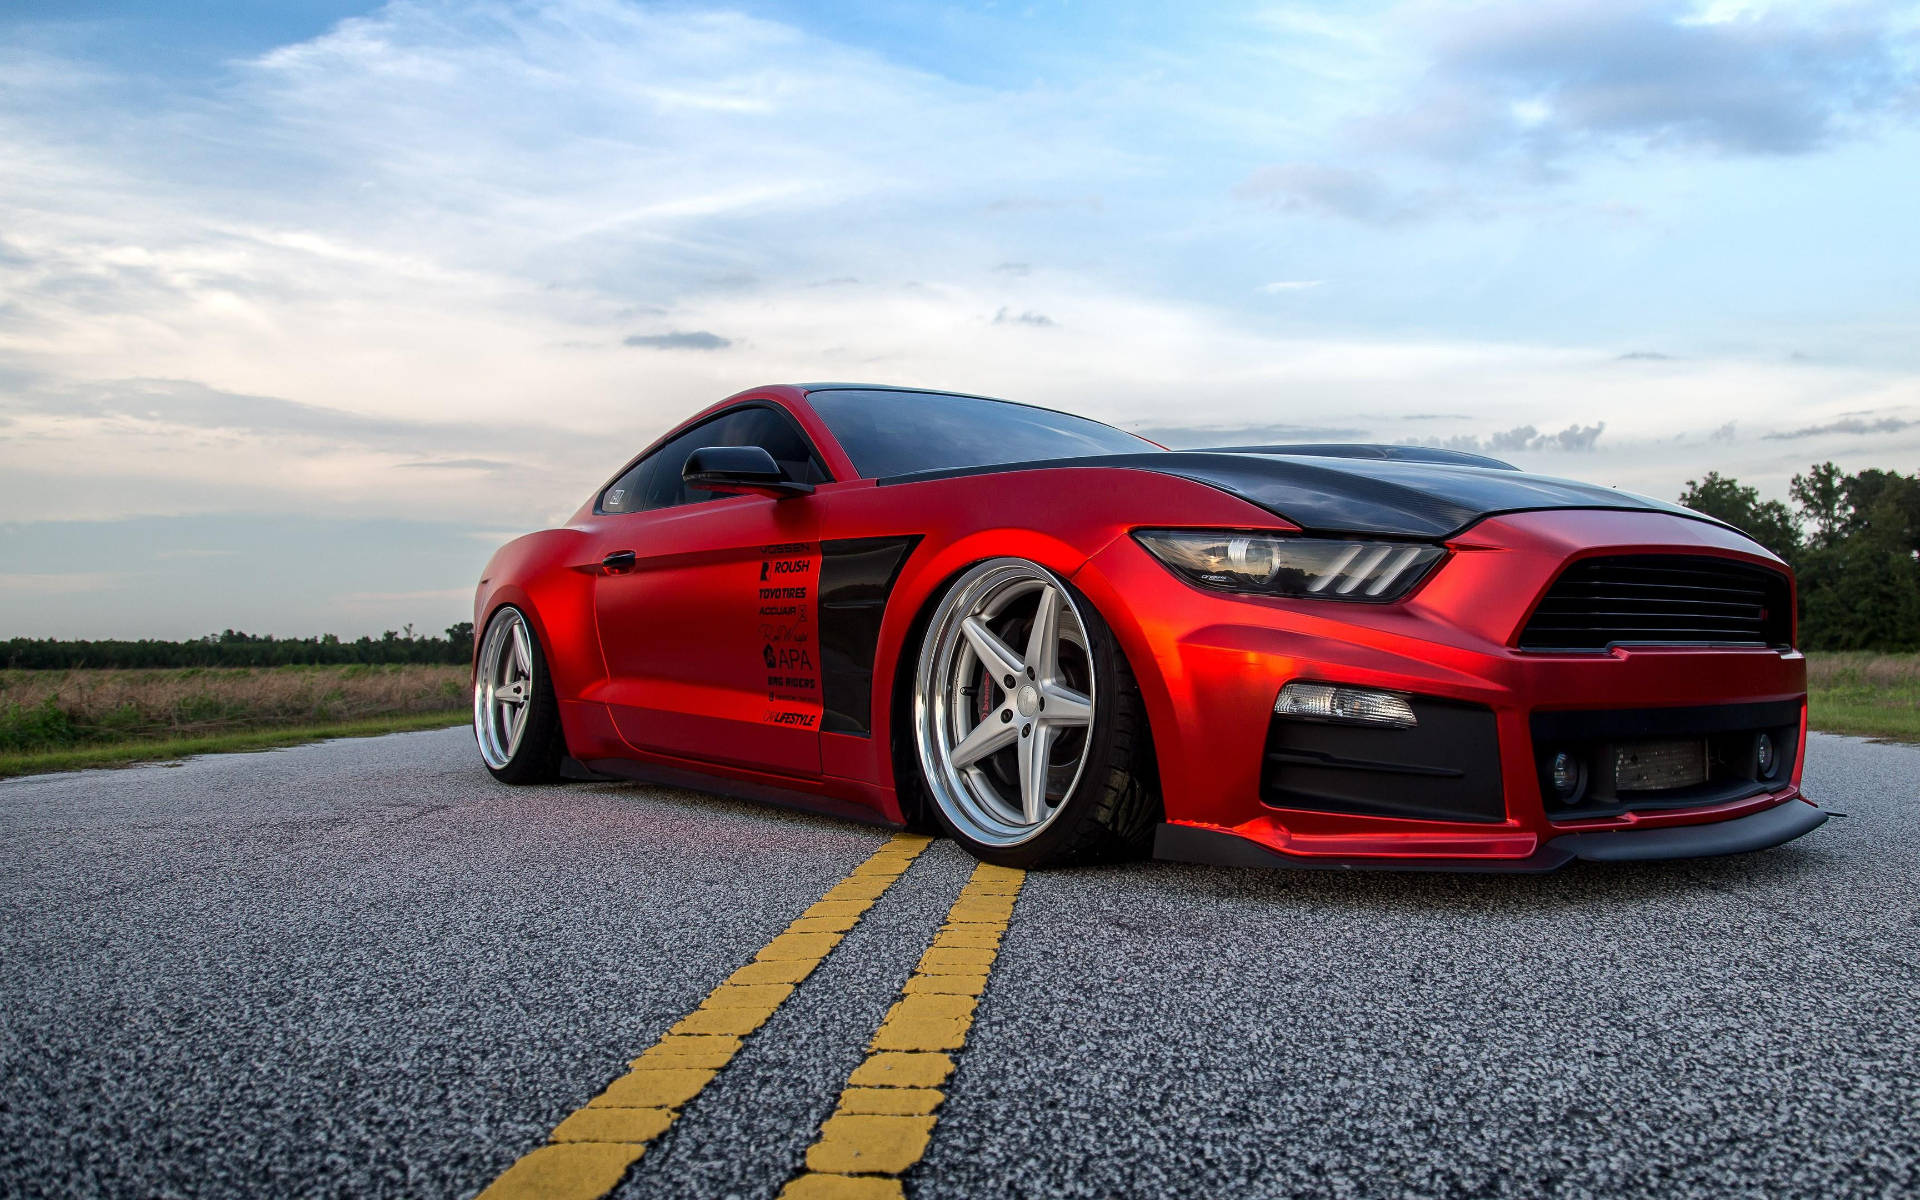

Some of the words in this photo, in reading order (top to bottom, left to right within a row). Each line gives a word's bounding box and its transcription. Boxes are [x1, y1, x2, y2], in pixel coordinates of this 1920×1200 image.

[775, 560, 810, 573] ROUSH
[780, 648, 813, 670] APA
[774, 711, 816, 727] LIFESTYLE
